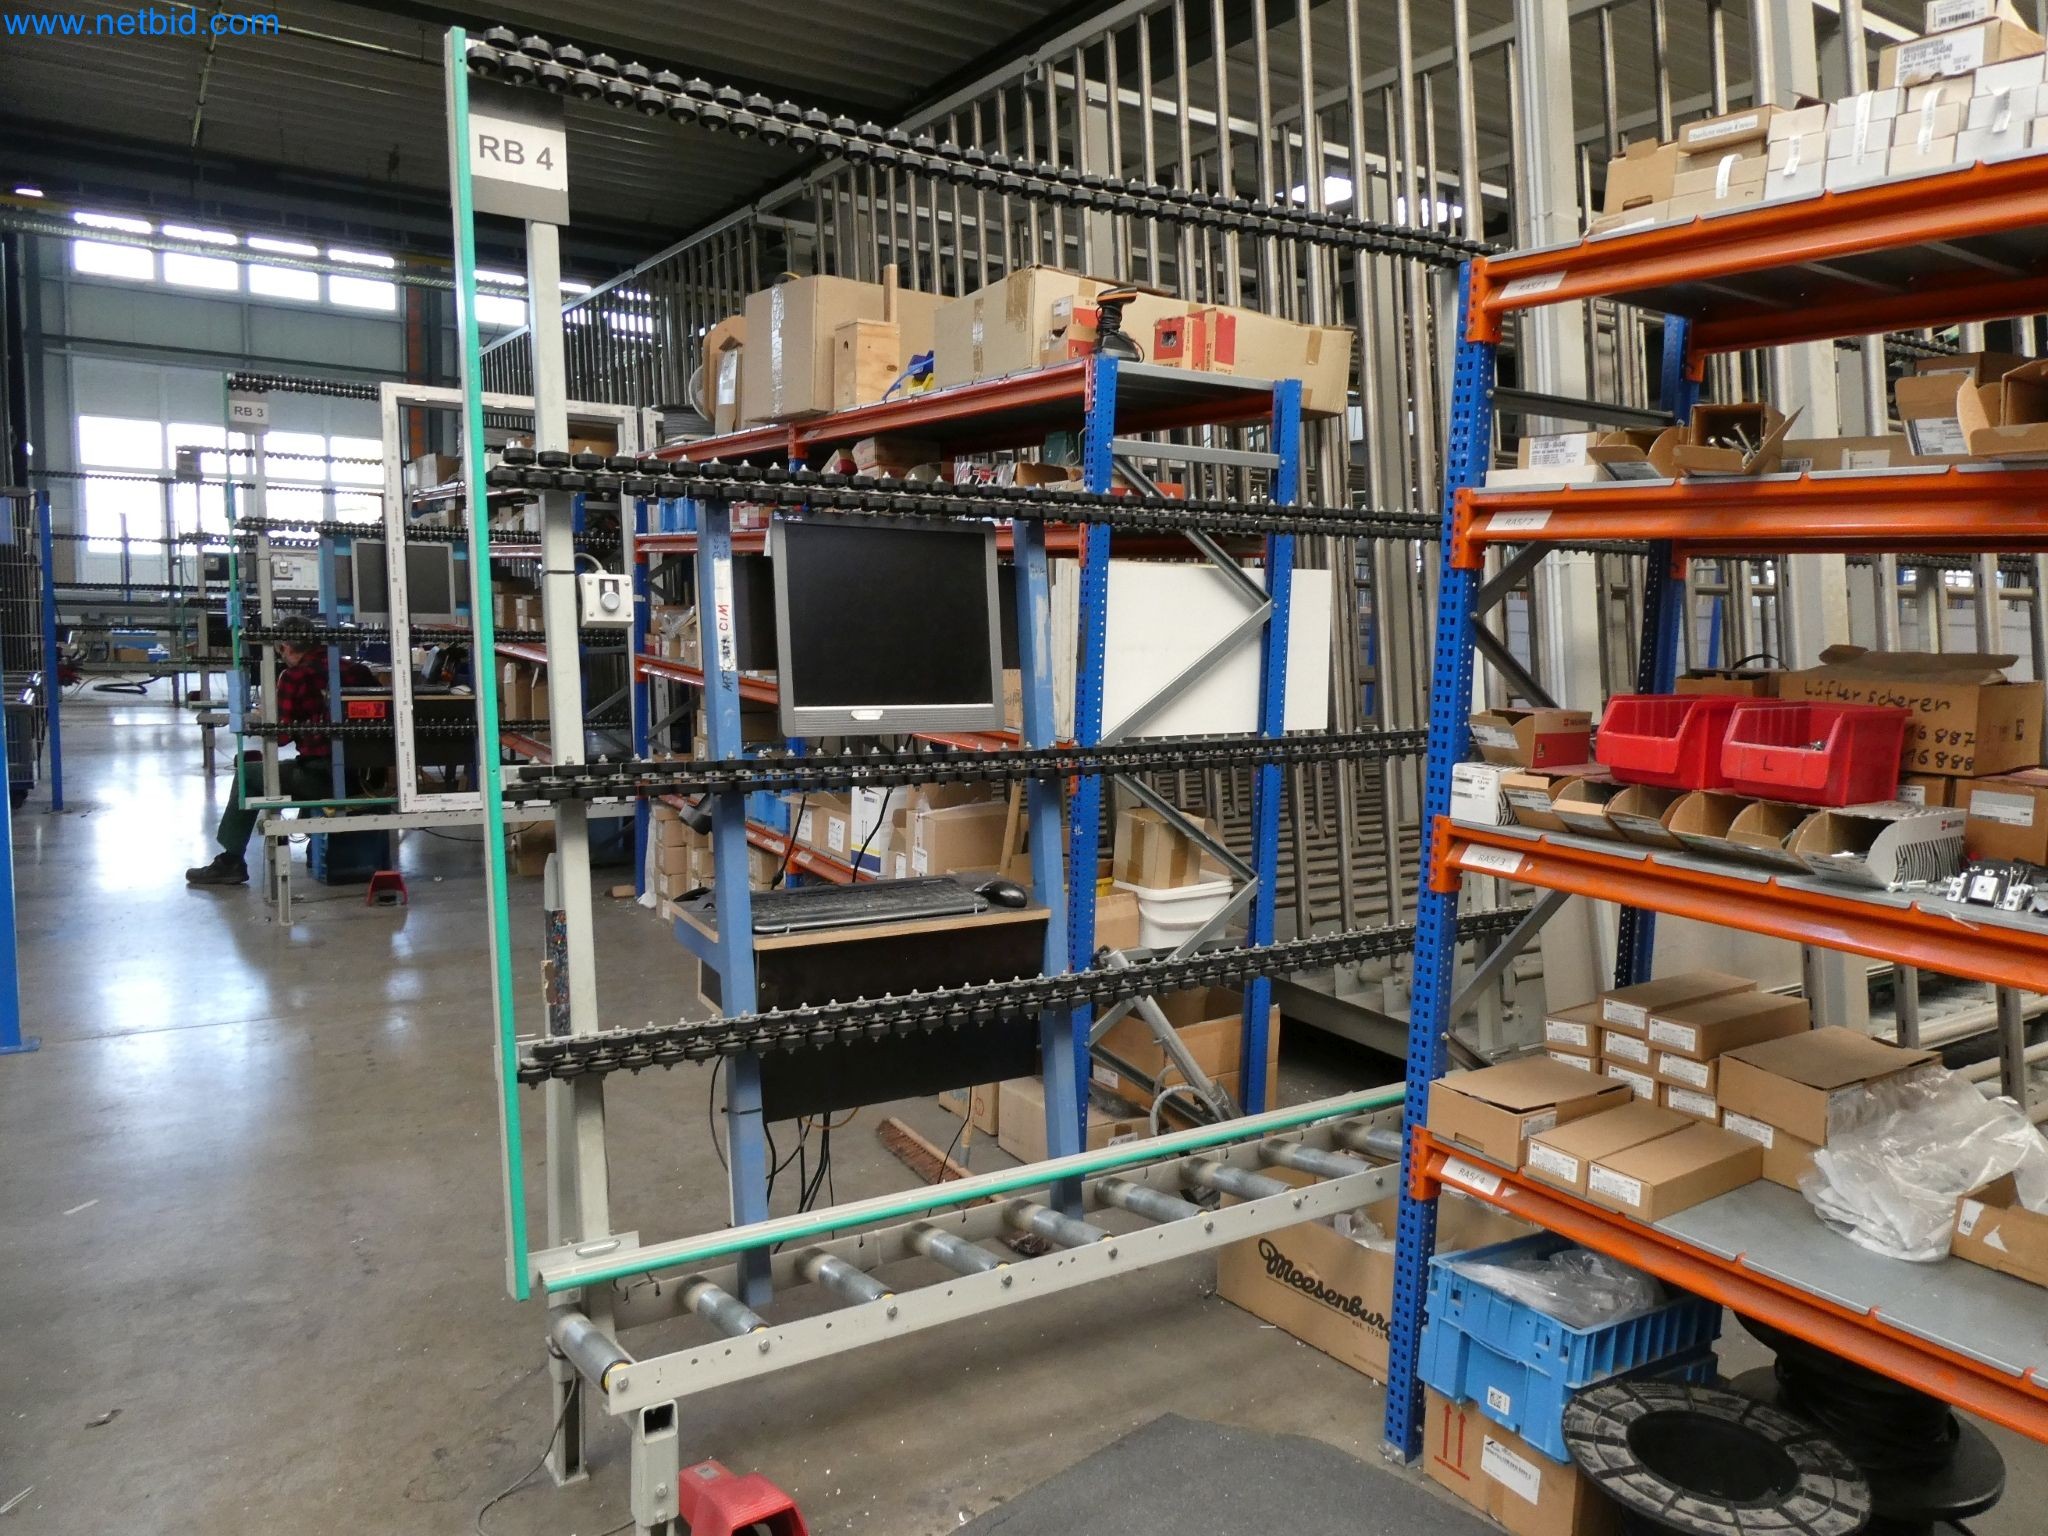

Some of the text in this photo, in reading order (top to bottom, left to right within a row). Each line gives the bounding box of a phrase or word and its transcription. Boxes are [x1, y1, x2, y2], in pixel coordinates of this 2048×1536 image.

[479, 134, 554, 171] RB 4
[234, 405, 264, 418] RB 3
